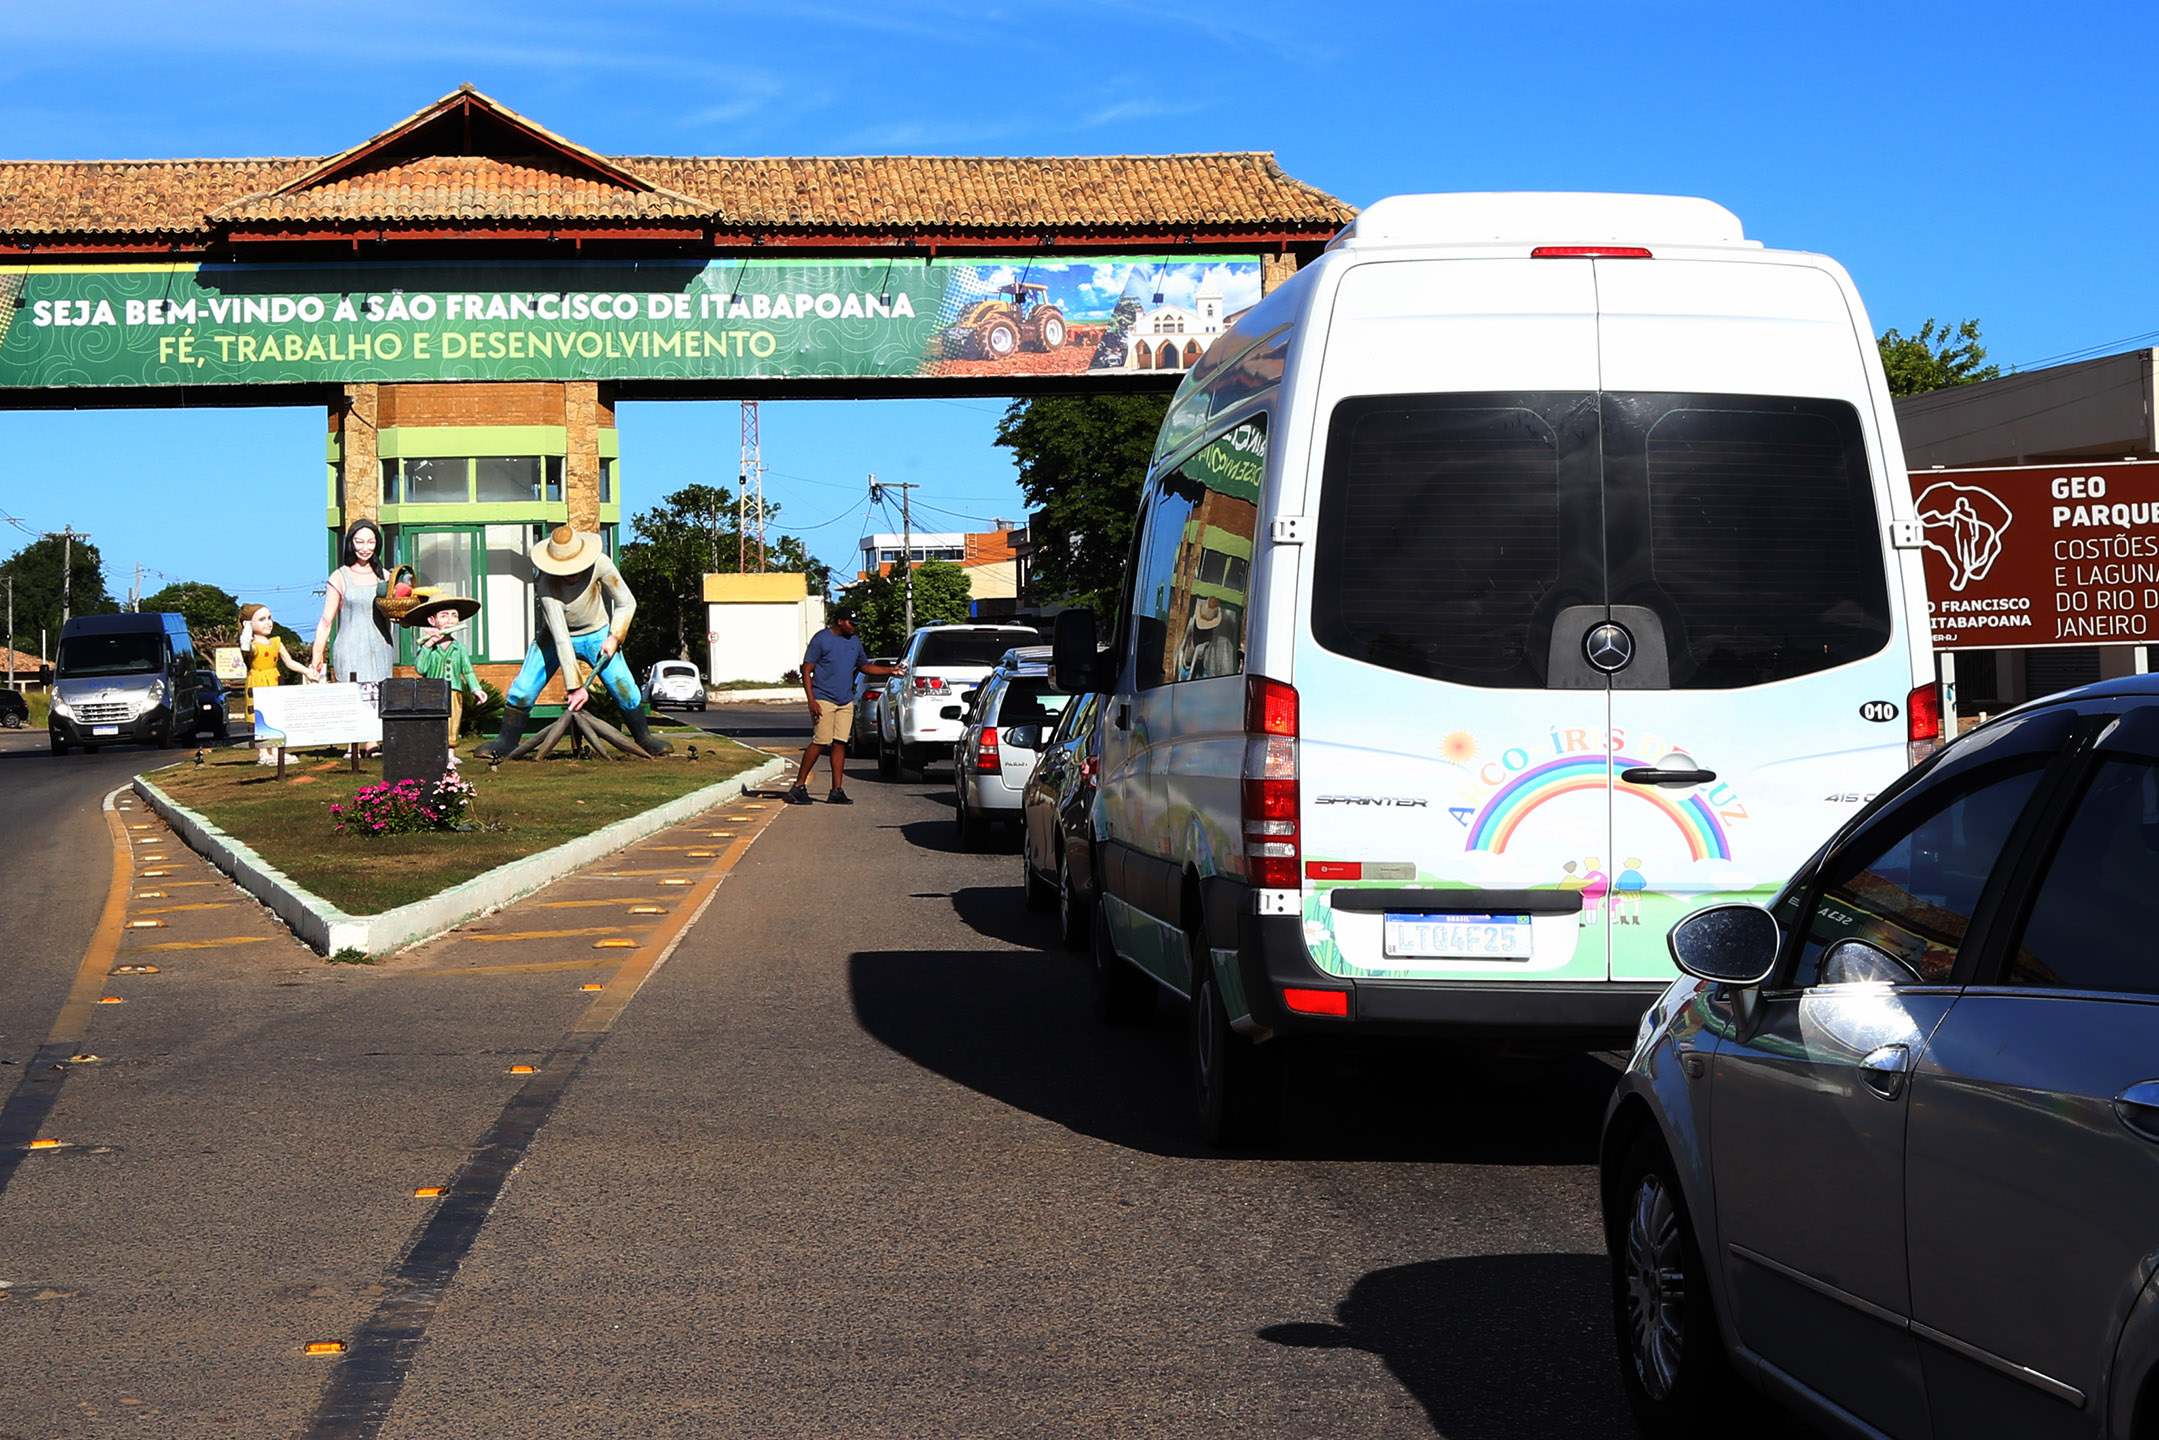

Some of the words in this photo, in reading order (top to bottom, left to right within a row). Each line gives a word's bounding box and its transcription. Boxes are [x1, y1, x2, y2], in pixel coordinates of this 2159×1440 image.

[32, 299, 117, 326] SEJA
[125, 296, 323, 325] BEM-VINDO
[333, 296, 360, 322] A
[365, 288, 437, 322] SÃO
[446, 293, 639, 320] FRANCISCO
[648, 293, 693, 319] DE
[701, 292, 916, 319] ITABAPOANA
[159, 328, 206, 369] FÉ,
[214, 332, 403, 362] TRABALHO
[413, 332, 431, 359] E
[442, 330, 777, 359] DESENVOLVIMENTO
[2051, 476, 2106, 499] GEO
[2054, 532, 2159, 560] COSTÕES
[2055, 566, 2068, 587] E
[2076, 563, 2159, 586] LAGUN
[1941, 597, 2031, 613] FRANCISCO
[2056, 591, 2088, 612] DO
[2097, 589, 2135, 611] RIO
[1930, 614, 2032, 630] ITABAPOANA
[2055, 614, 2147, 639] JANEIRO
[1931, 633, 1958, 642] ER-RJ
[1864, 703, 1894, 720] 010
[1315, 795, 1430, 807] SPRINTER
[1698, 765, 1749, 827] UZ
[1824, 793, 1860, 803] 415
[1446, 915, 1470, 923] BRASIL
